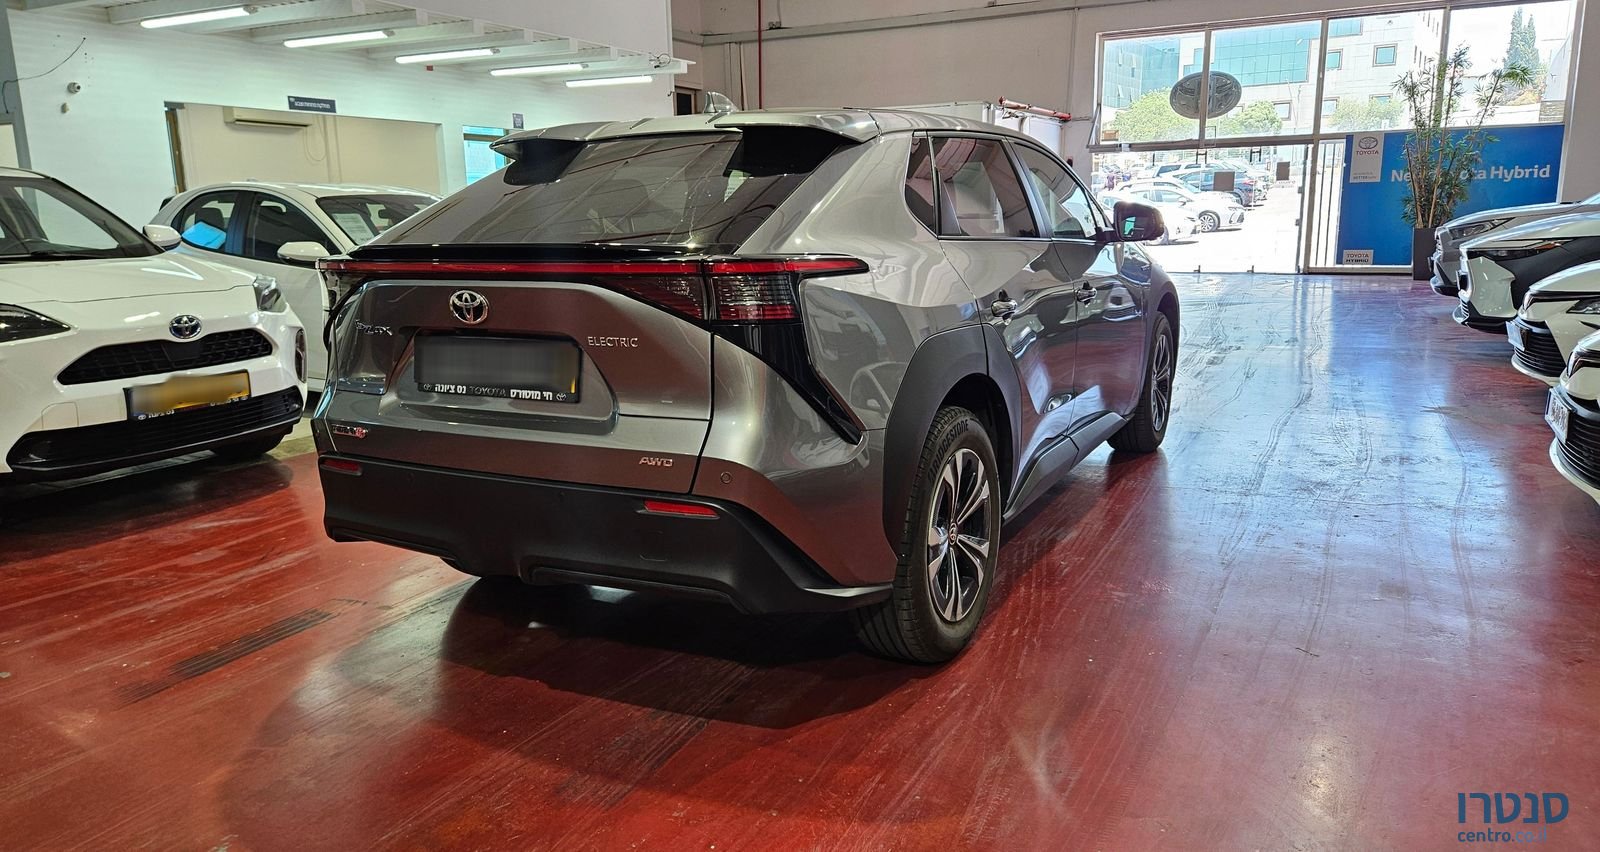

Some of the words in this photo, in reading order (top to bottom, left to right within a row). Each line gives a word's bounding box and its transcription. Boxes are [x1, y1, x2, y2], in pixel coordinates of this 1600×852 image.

[1490, 165, 1551, 182] Hybrid
[587, 336, 639, 348] ELECTRIC
[435, 384, 455, 394] ציונה
[457, 385, 467, 394] נס
[469, 386, 507, 397] TOYOTA
[510, 389, 541, 400] מוטורס
[543, 390, 553, 401] חי
[927, 418, 969, 483] BRIDGESTONE
[639, 456, 673, 467] AWD
